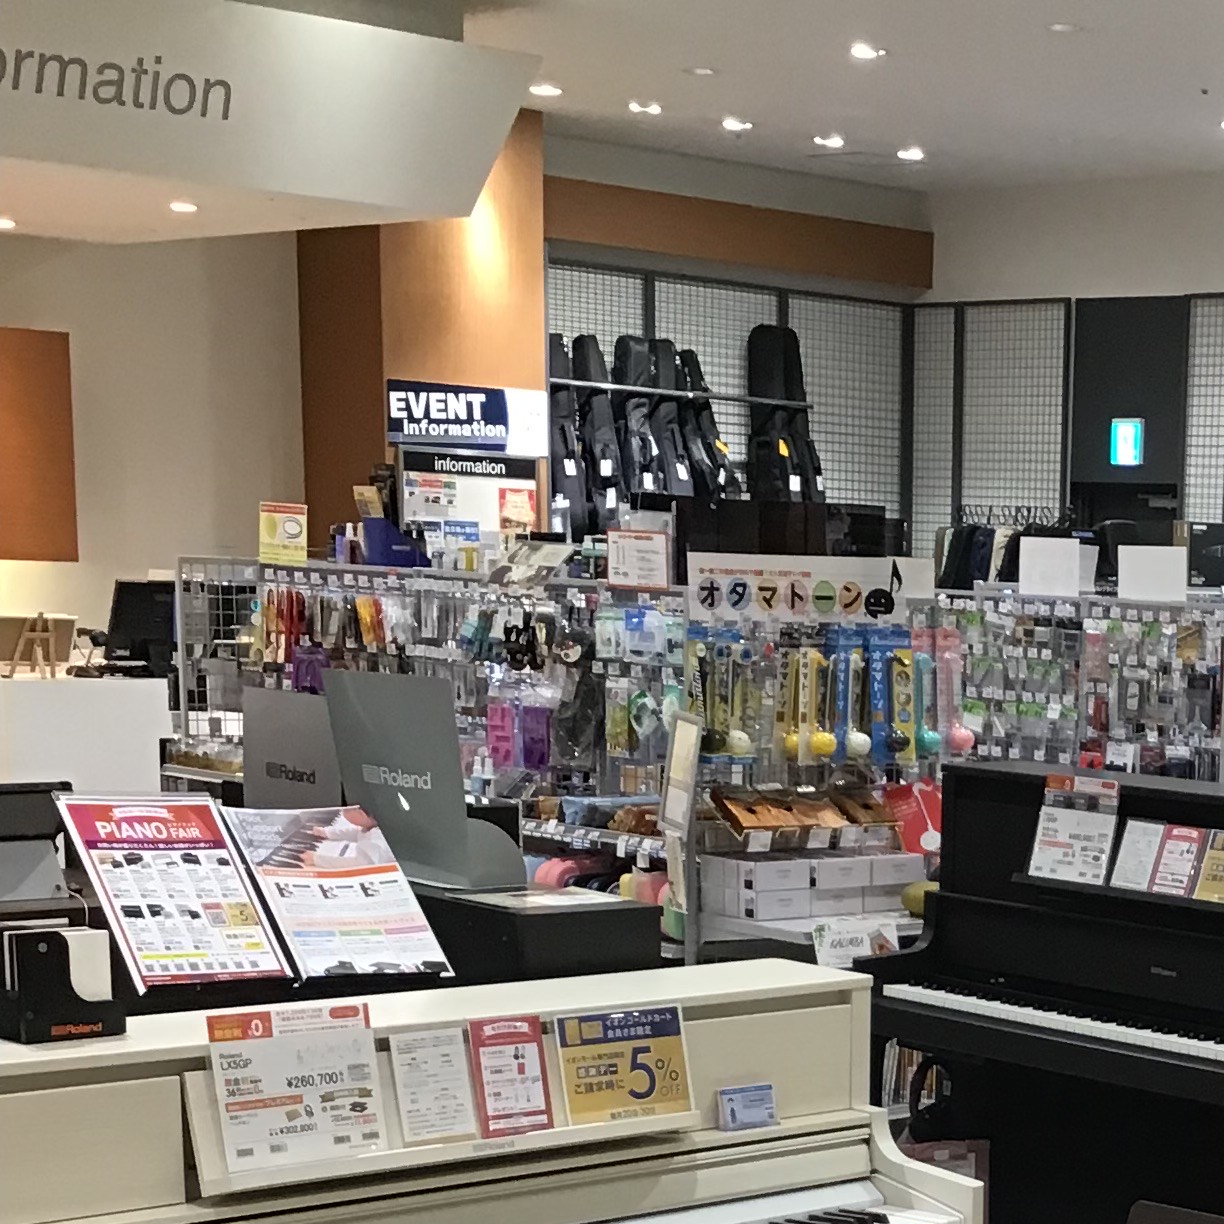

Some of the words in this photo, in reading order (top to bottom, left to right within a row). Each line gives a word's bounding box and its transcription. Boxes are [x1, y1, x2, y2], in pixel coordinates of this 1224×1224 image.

[0, 48, 231, 120] rmation
[389, 391, 486, 420] EVENT
[403, 420, 506, 437] Information
[434, 457, 506, 475] information
[699, 580, 862, 609] オタマトーン
[279, 763, 316, 785] Roland
[378, 767, 432, 790] Roland
[95, 821, 168, 840] PIANO
[169, 827, 202, 839] FAIR
[67, 1022, 102, 1034] Roland
[286, 1071, 339, 1089] ¥260,700
[660, 1084, 681, 1098] OFF
